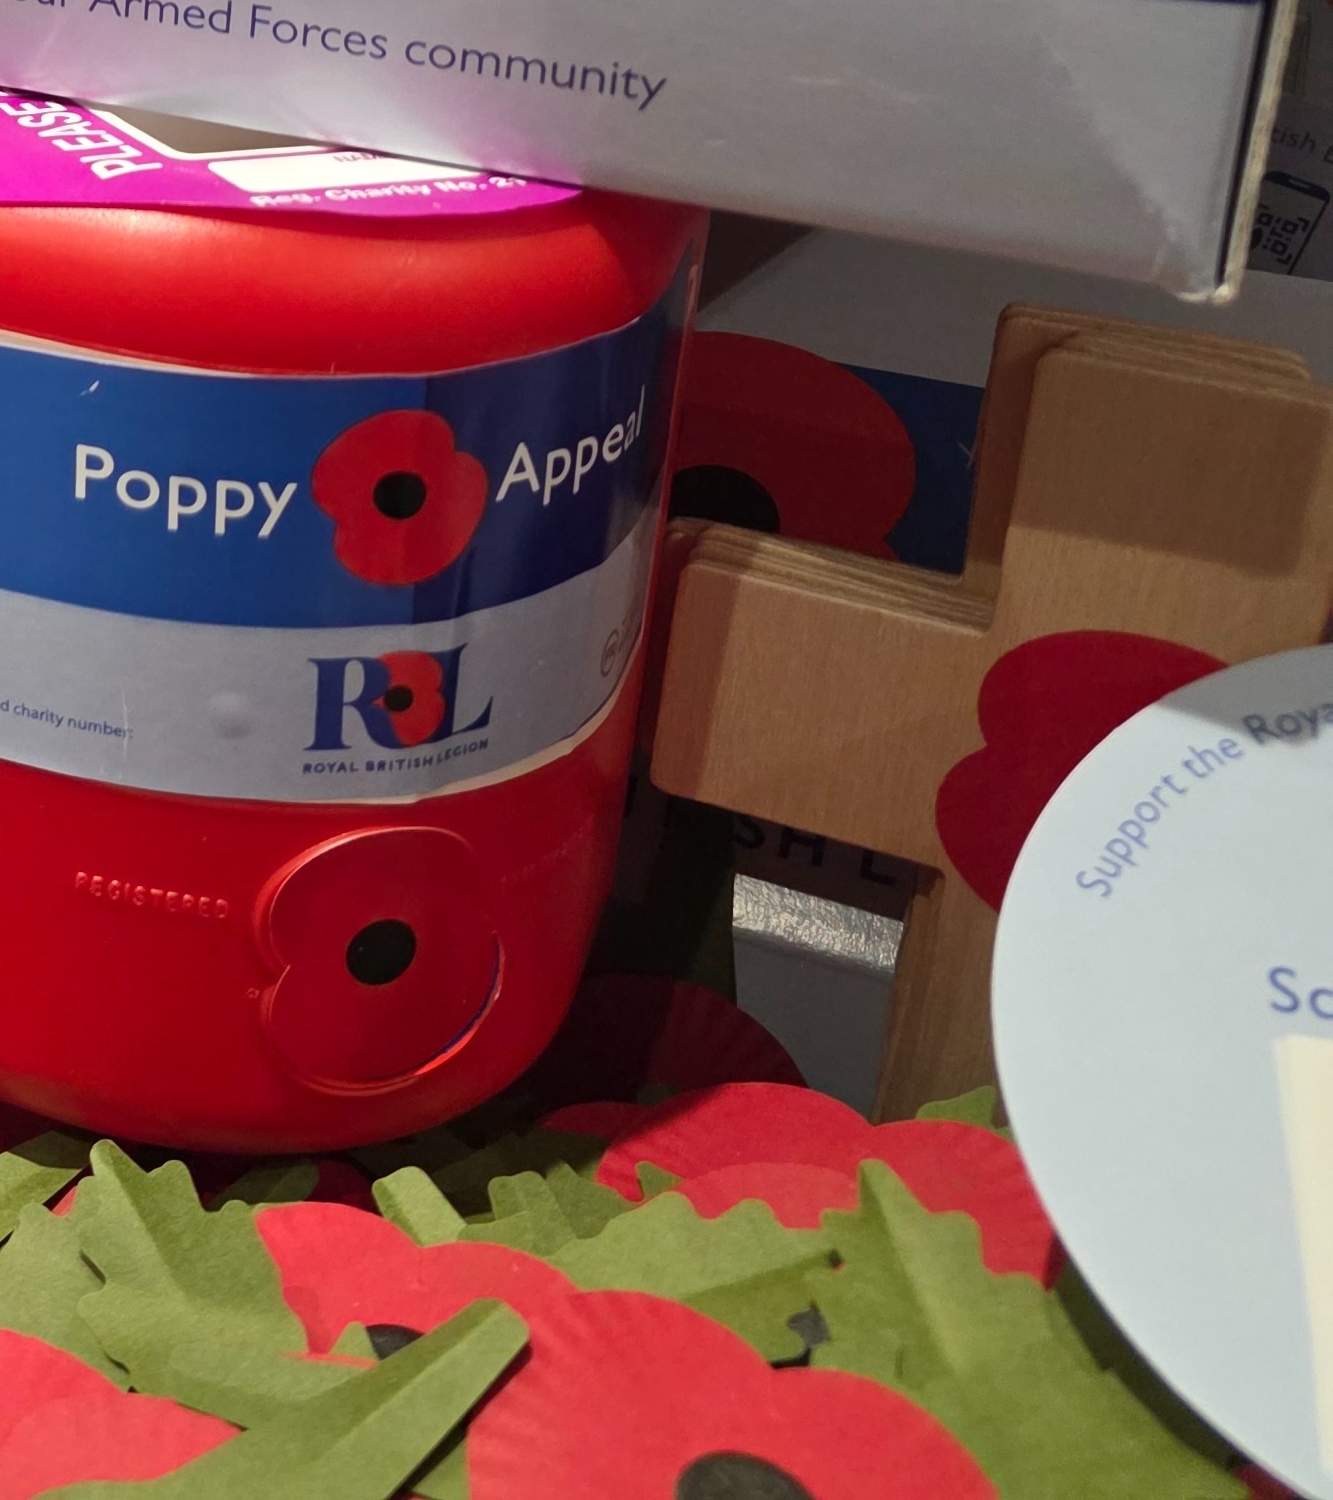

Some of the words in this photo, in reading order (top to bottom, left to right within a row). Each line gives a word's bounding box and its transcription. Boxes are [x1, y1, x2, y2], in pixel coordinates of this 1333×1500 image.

[247, 0, 389, 65] Forces
[403, 34, 669, 114] community
[249, 193, 322, 208] Reg.
[324, 183, 432, 203] Charity
[433, 179, 488, 192] No.
[74, 442, 298, 539] Poppy
[495, 384, 647, 506] Appeal
[12, 703, 65, 729] charity
[66, 716, 134, 739] number:
[302, 760, 360, 775] ROYAL
[364, 755, 434, 774] BRITISH
[436, 738, 490, 765] LEGION
[1074, 773, 1189, 899] Support
[1180, 736, 1246, 780] the
[1241, 702, 1333, 746] Roya
